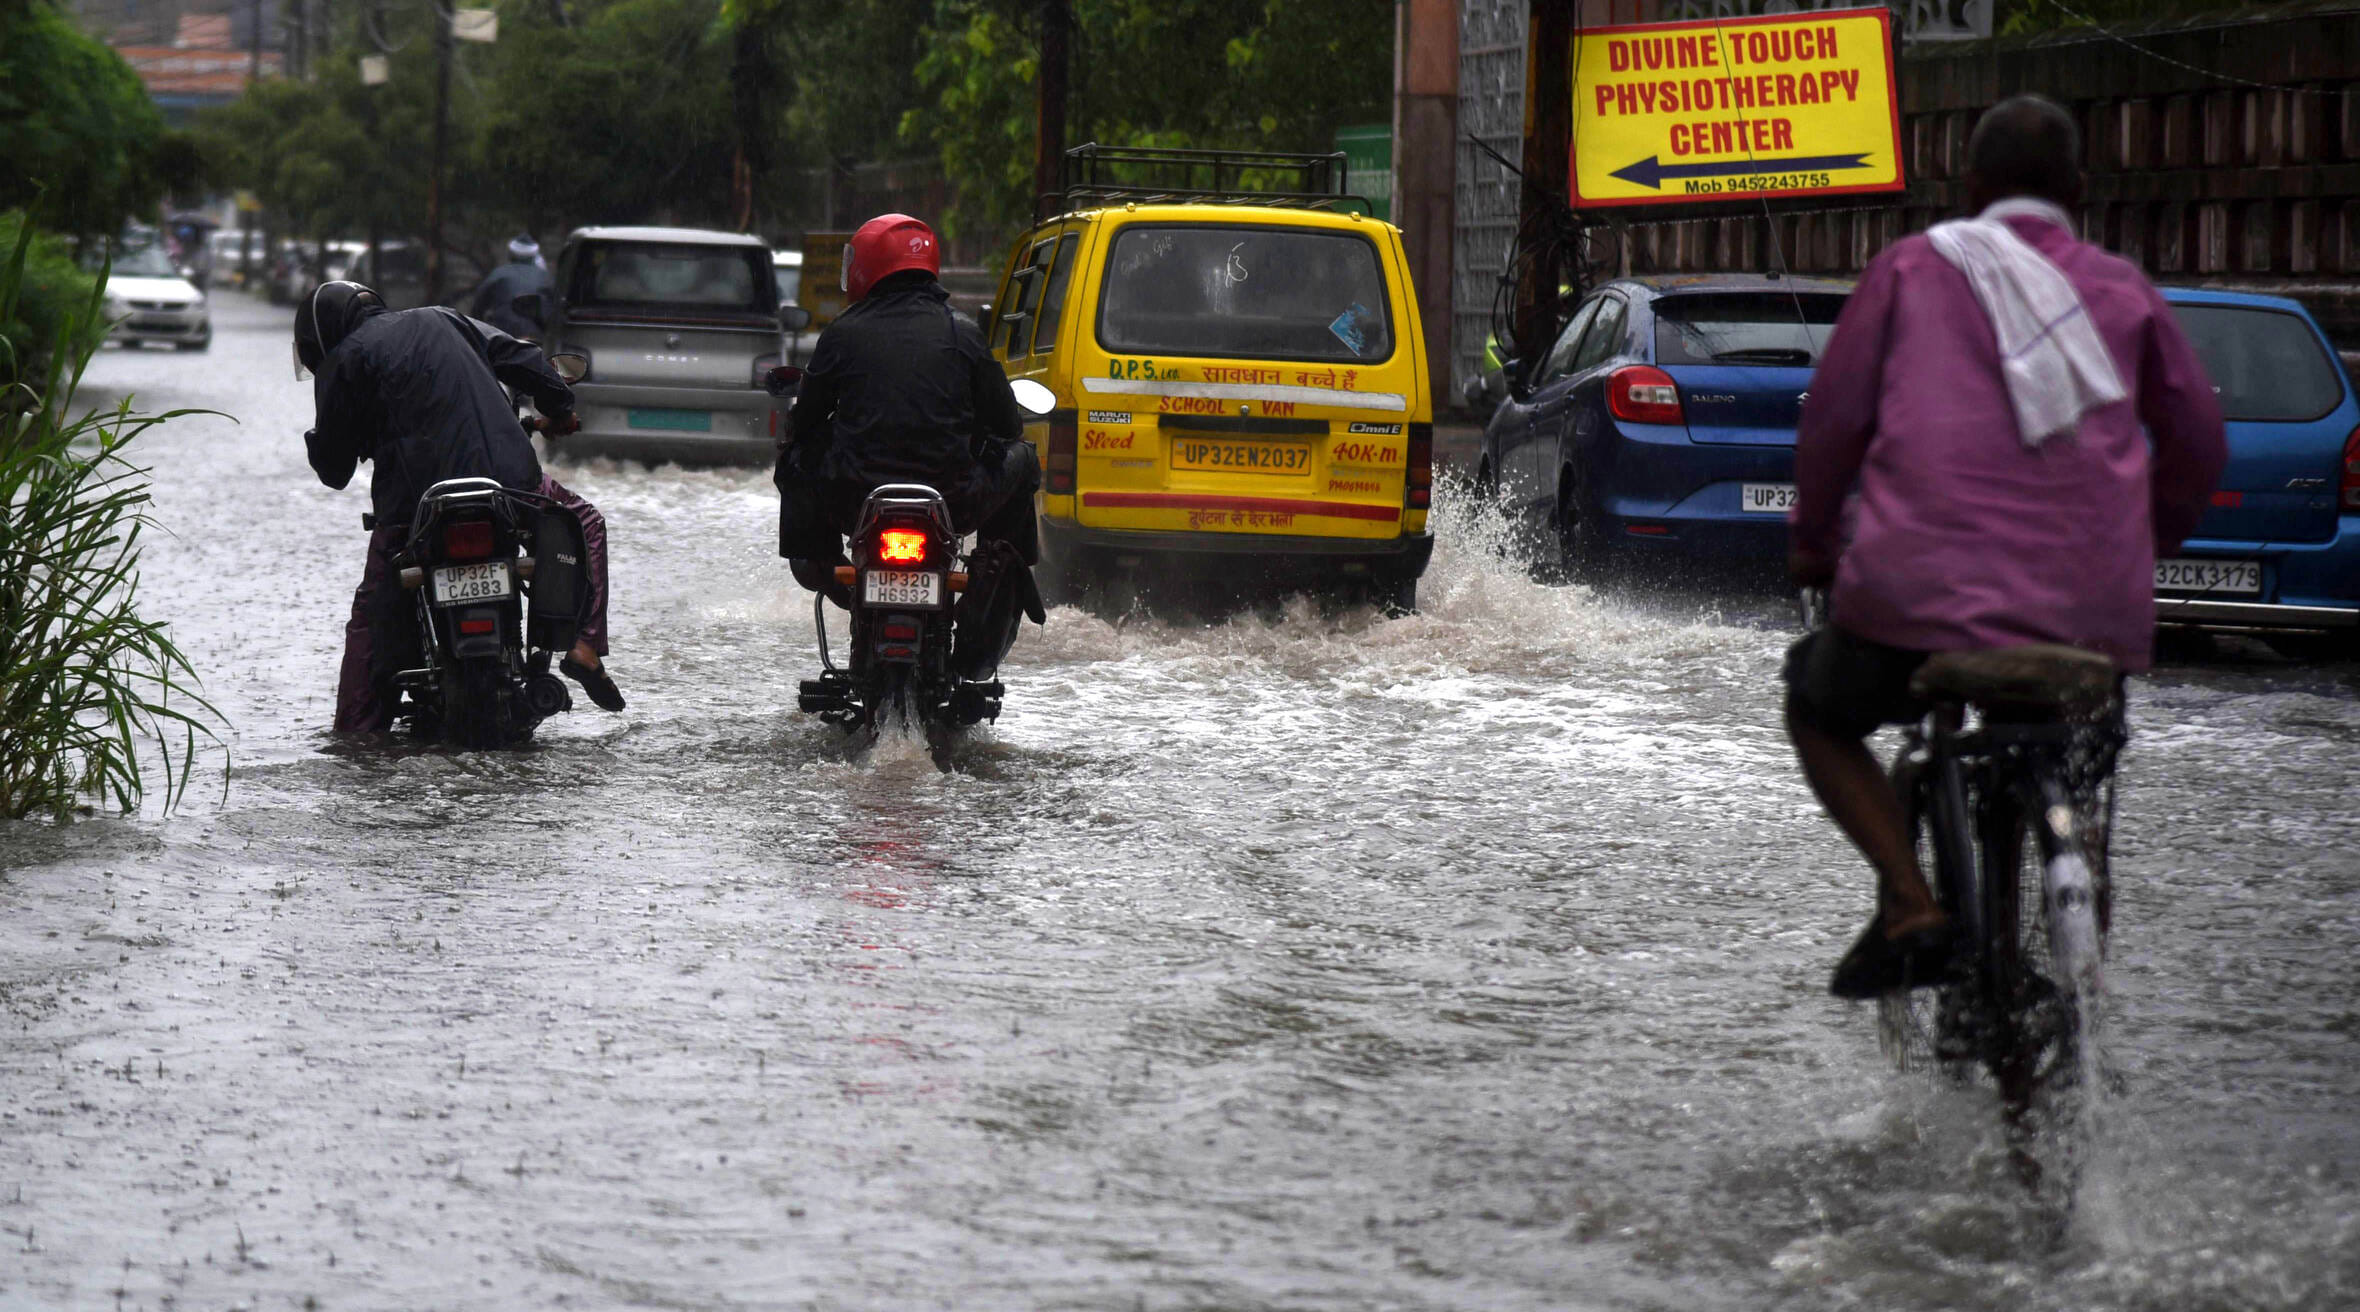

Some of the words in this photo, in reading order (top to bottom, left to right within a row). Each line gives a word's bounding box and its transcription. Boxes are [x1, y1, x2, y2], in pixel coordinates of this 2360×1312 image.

[1608, 35, 1719, 72] DIVINE
[1729, 26, 1838, 65] TOUCH
[1595, 68, 1859, 116] PHYSIOTHERAPY
[1670, 118, 1794, 156] CENTER
[1685, 180, 1722, 194] Mob
[1727, 173, 1831, 191] 9452243755
[1109, 359, 1158, 380] D.P.S.
[1201, 367, 1281, 384] सावधान
[1296, 368, 1337, 390] बच्चे
[1342, 369, 1358, 391] हैं
[1159, 396, 1227, 415] SCHOOL
[1262, 400, 1295, 416] VAN
[1089, 416, 1131, 424] SUZUKI
[1185, 444, 1309, 469] UP32EN2037
[446, 564, 500, 582] UP32F
[2156, 564, 2260, 588] 32CK3179
[449, 580, 501, 599] C4883
[878, 587, 929, 603] H6932
